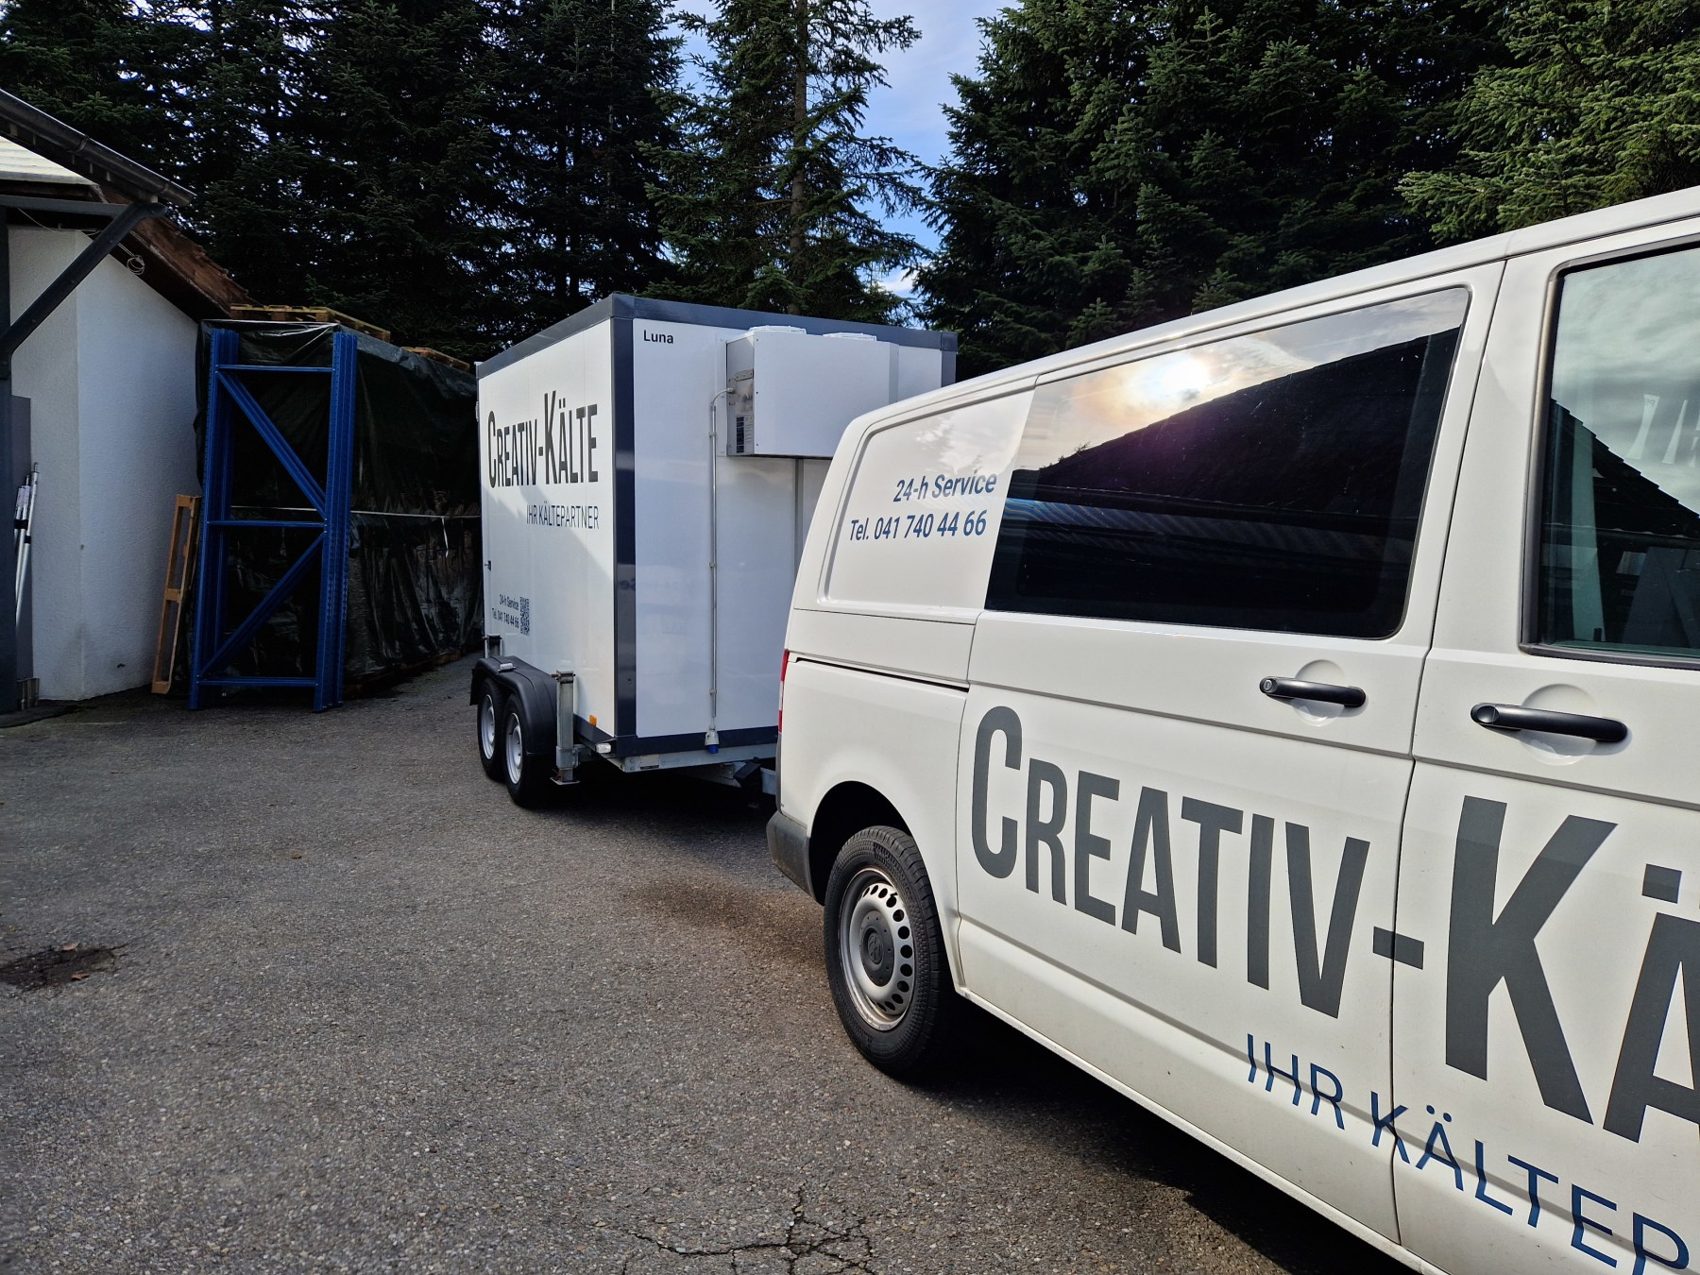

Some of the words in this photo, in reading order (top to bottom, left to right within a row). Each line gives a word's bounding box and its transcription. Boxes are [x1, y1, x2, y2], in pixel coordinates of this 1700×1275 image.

[643, 329, 674, 344] Luna
[487, 390, 598, 488] CREATIV-KÄLTE
[892, 475, 929, 503] 24-h
[931, 473, 998, 499] Service
[526, 504, 538, 521] IHR
[538, 500, 600, 530] KÄLTEPARTNER
[849, 517, 869, 541] Tel.
[873, 516, 901, 540] 041
[903, 513, 934, 539] 740
[936, 511, 960, 537] 44
[962, 509, 988, 537] 66
[1246, 1033, 1346, 1131] IHR
